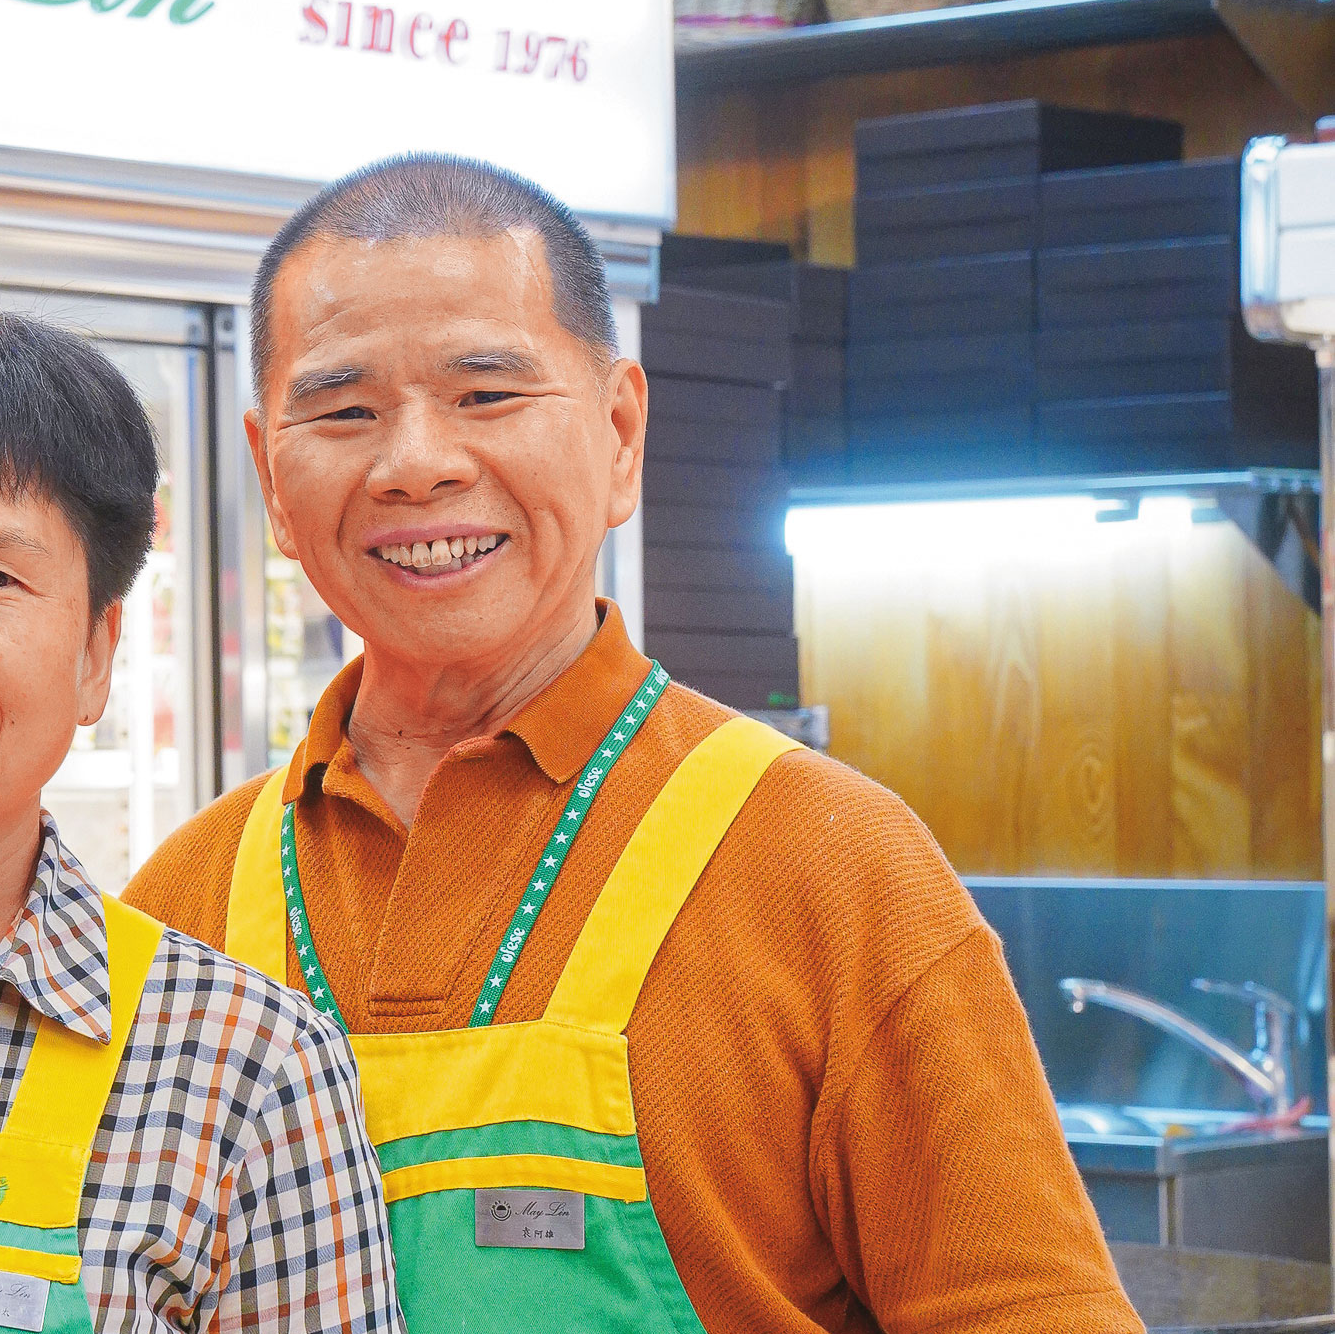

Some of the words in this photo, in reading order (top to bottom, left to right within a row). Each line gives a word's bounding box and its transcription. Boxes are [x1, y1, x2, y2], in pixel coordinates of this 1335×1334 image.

[493, 28, 590, 83] 1976
[514, 1201, 544, 1220] May
[544, 1201, 571, 1217] Lin
